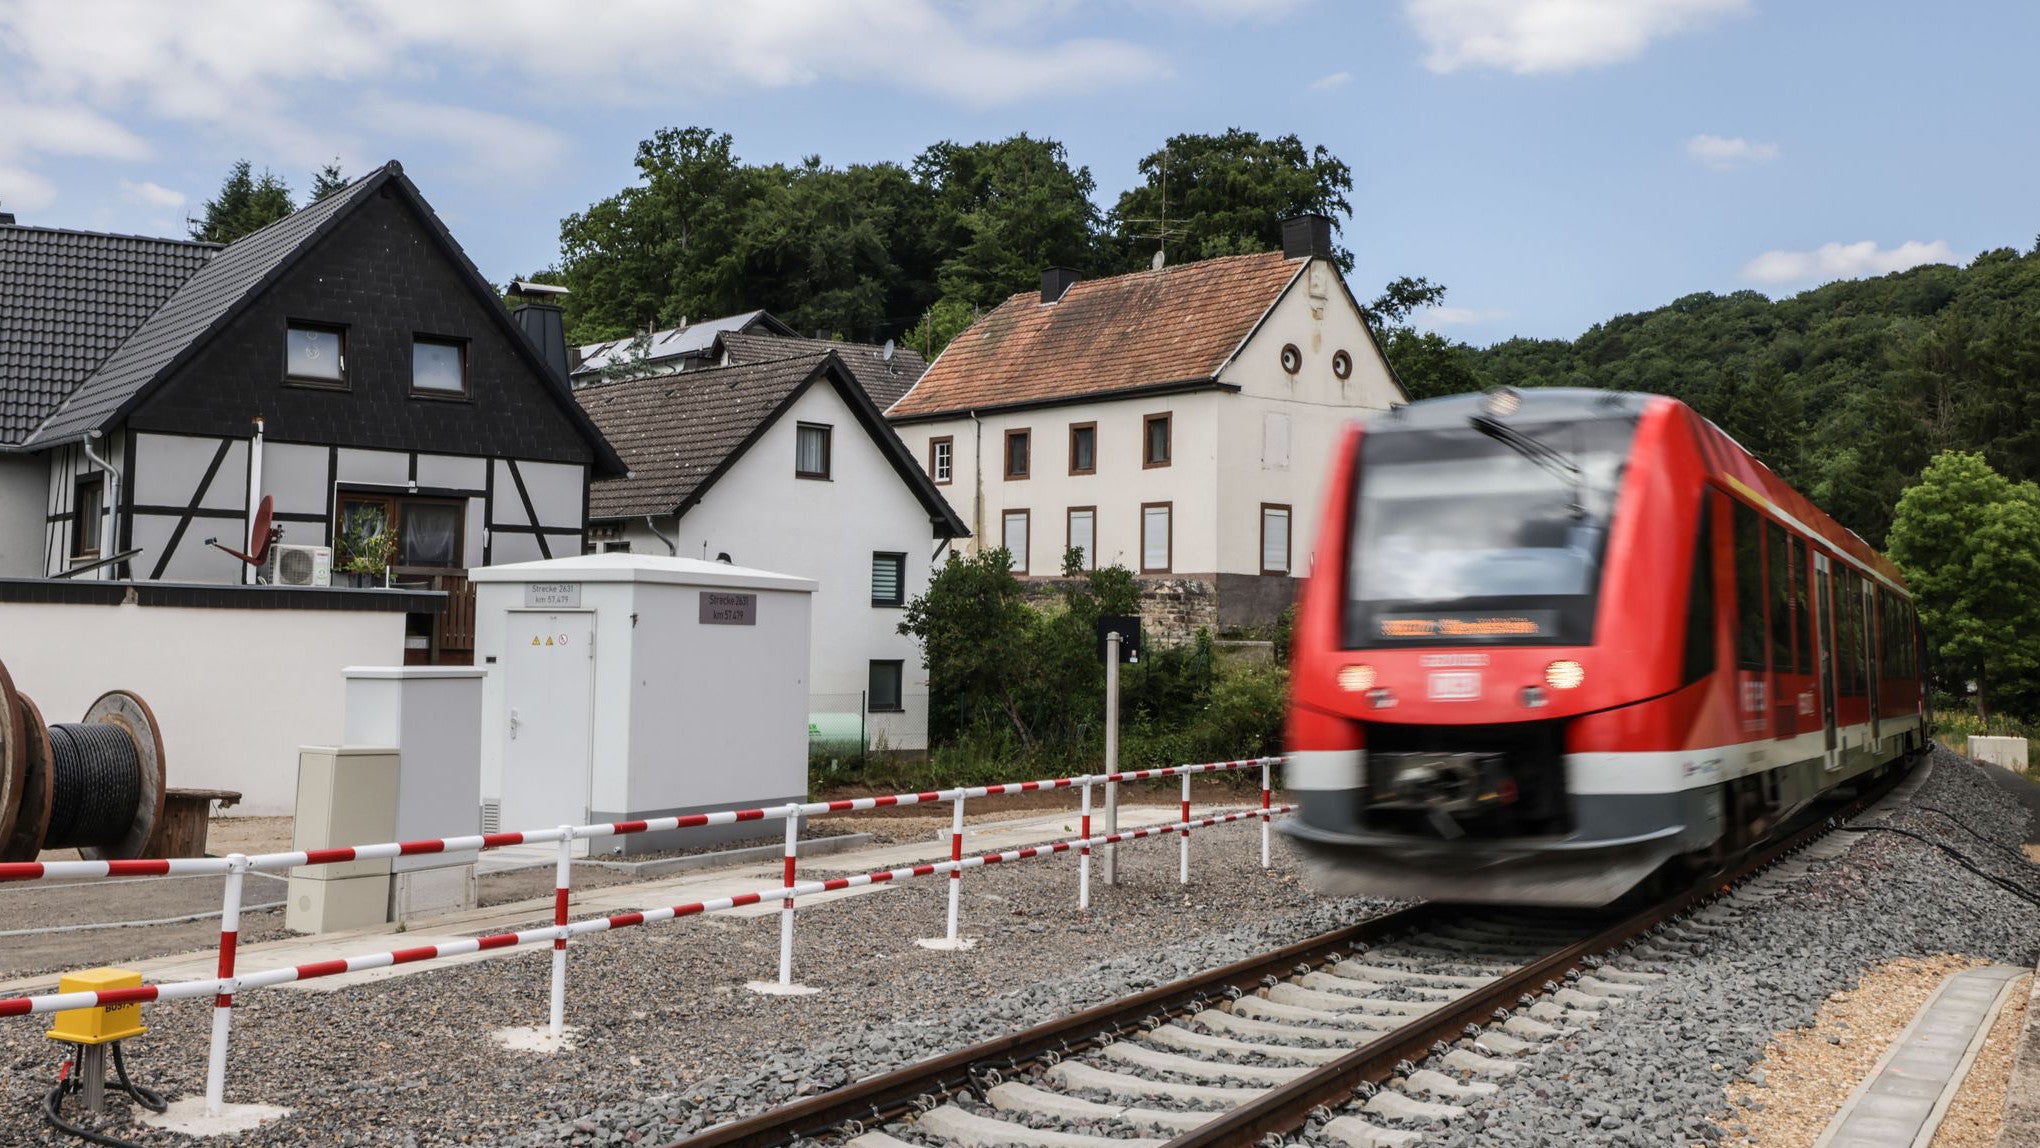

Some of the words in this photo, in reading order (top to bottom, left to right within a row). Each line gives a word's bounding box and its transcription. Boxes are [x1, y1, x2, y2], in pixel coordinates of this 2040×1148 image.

[531, 584, 558, 593] Strecke
[559, 584, 574, 593] 2631
[535, 595, 546, 603] km
[709, 594, 734, 606] Strecke
[713, 609, 724, 620] km
